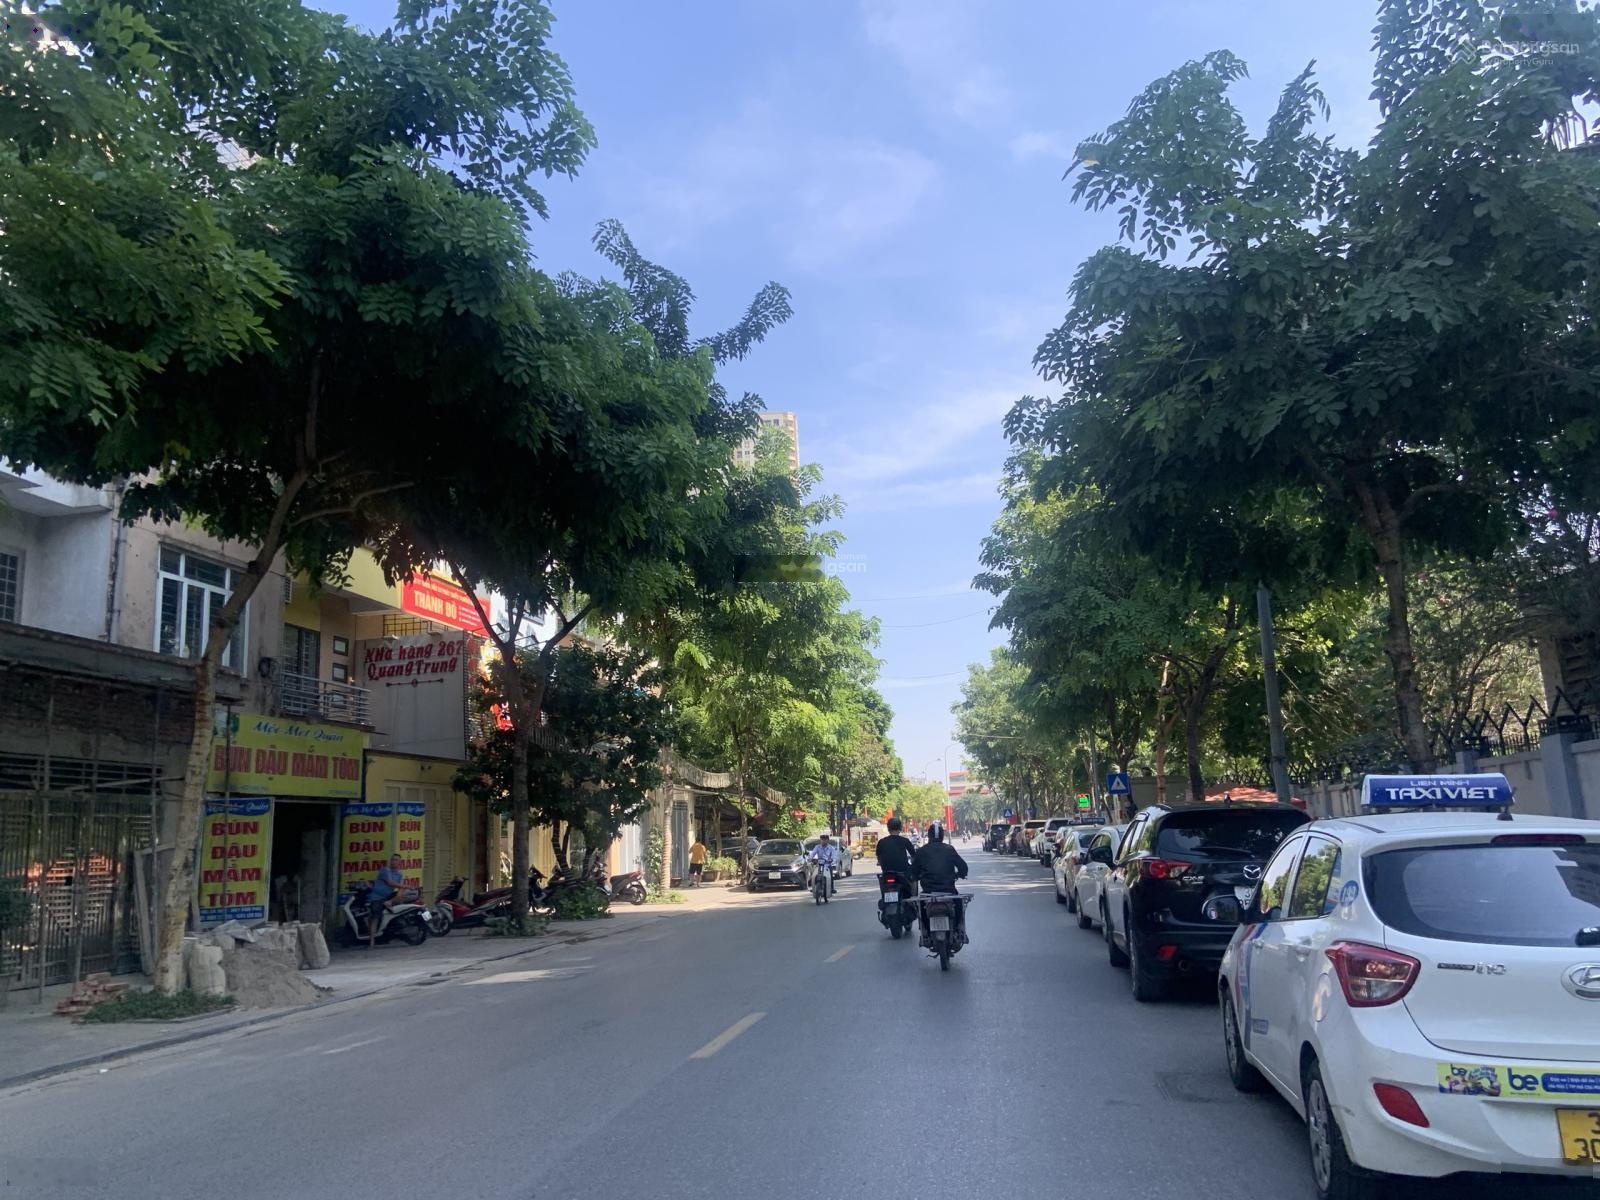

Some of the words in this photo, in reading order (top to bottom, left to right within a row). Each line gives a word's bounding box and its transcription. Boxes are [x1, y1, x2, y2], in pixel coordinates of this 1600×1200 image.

[437, 640, 464, 656] 267
[367, 660, 414, 681] Quang
[416, 657, 459, 675] Trung
[211, 819, 258, 836] BÚN
[349, 819, 385, 833] BÚN
[1451, 1063, 1467, 1076] be
[1507, 1067, 1540, 1091] be
